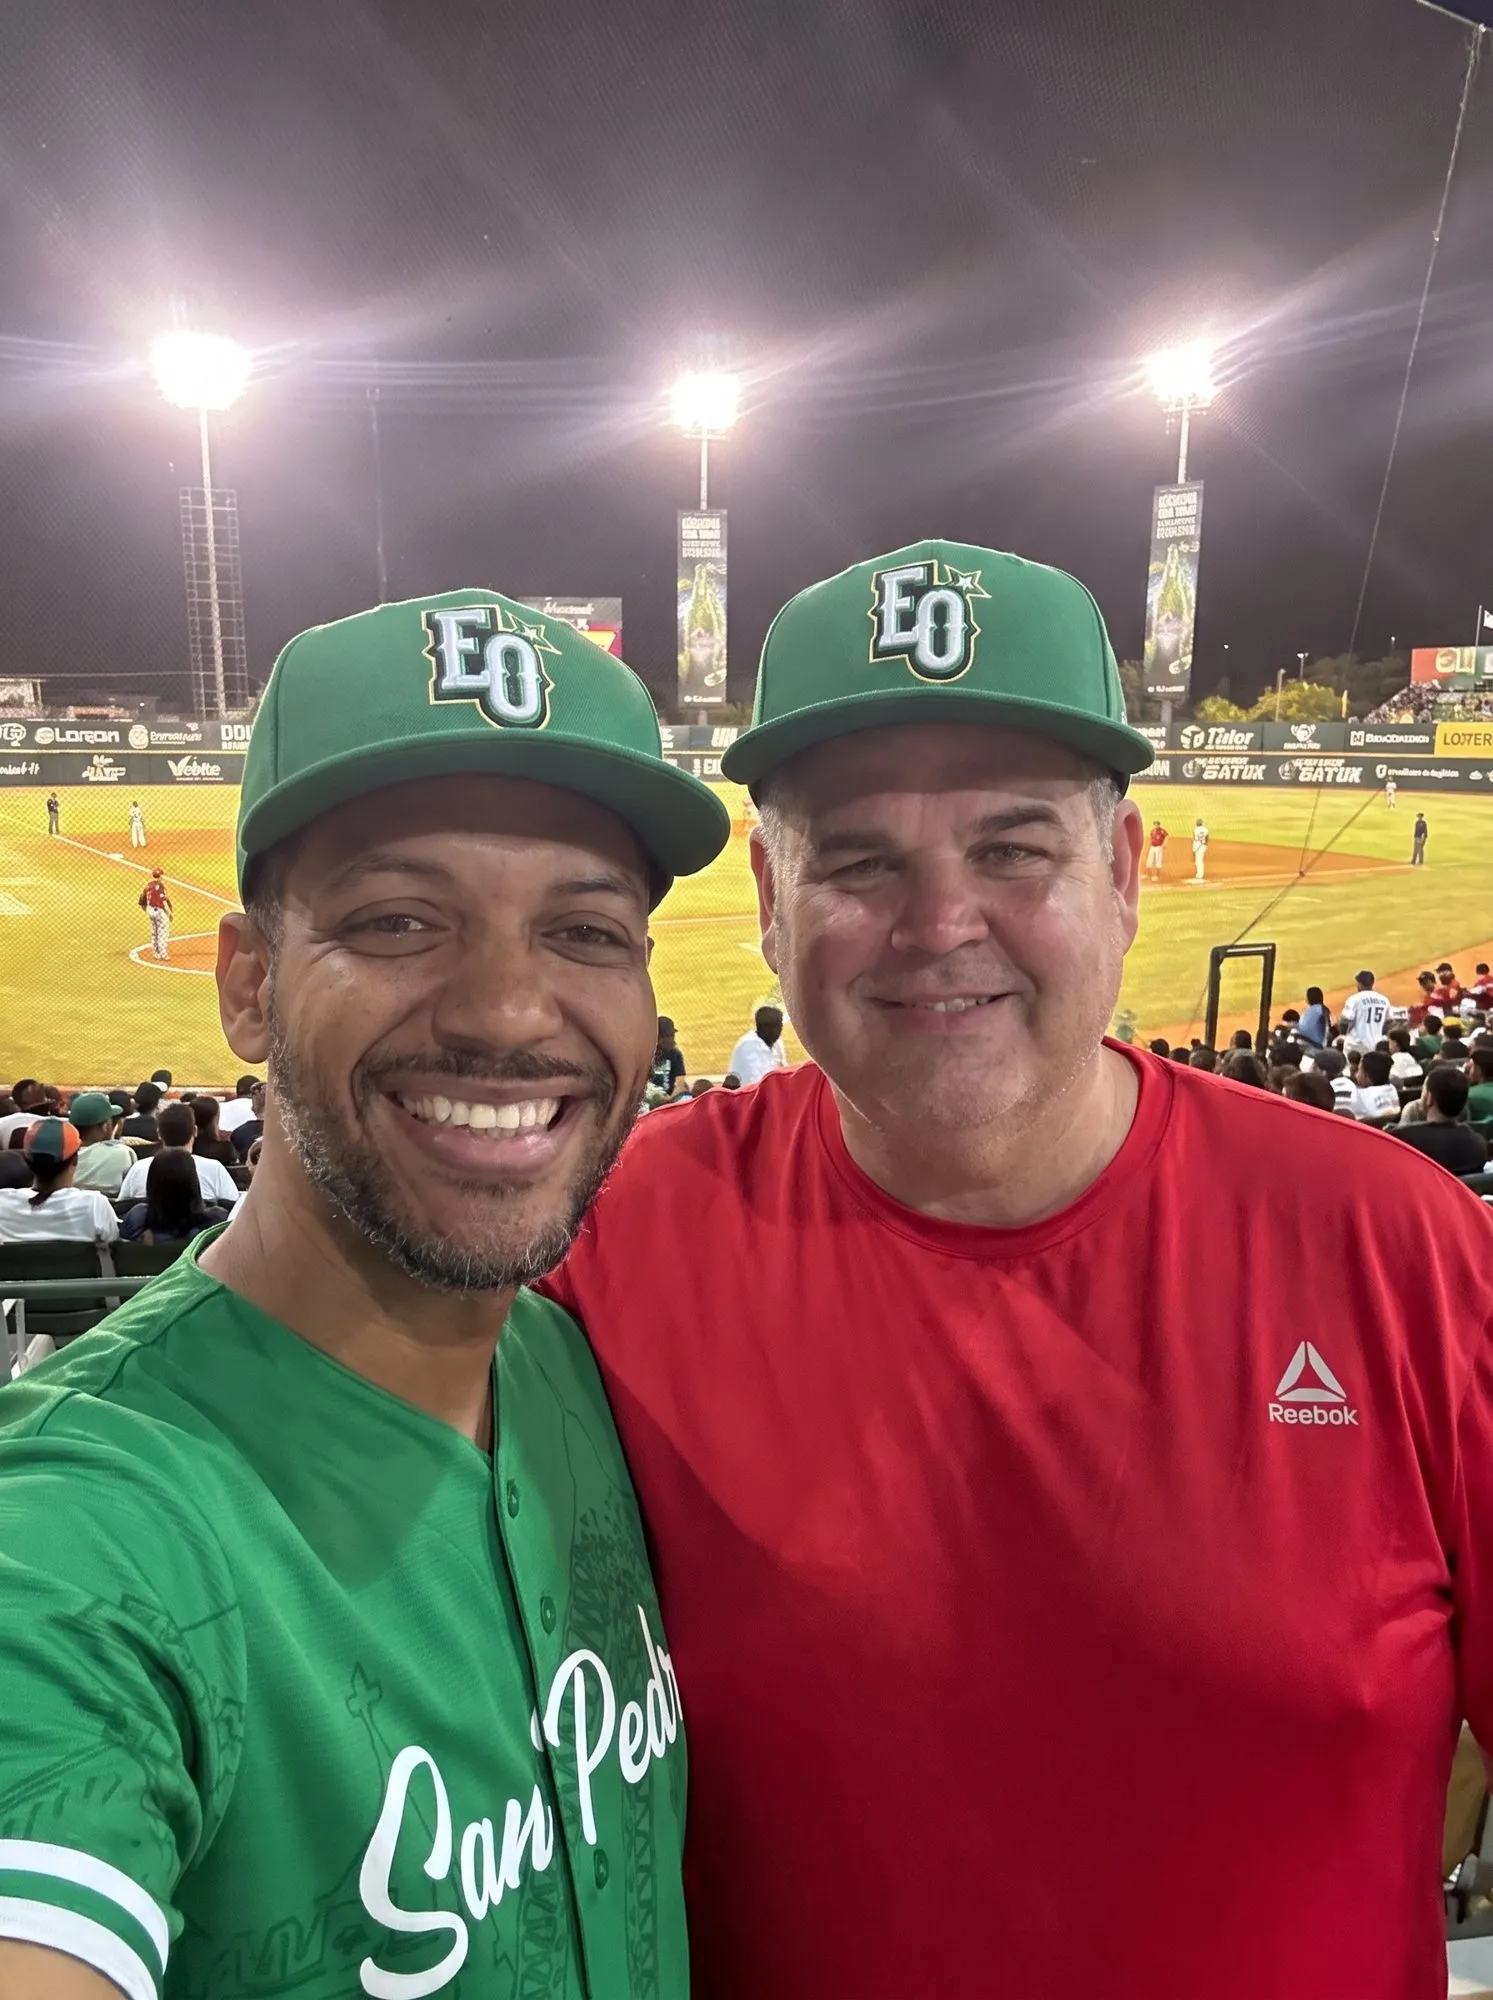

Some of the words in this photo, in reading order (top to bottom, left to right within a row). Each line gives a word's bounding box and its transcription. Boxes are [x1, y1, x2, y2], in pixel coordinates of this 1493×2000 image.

[431, 606, 546, 724] EO
[875, 564, 969, 674] EO
[1366, 1006, 1384, 1024] 15
[1268, 1403, 1359, 1425] Reebok
[359, 1745, 555, 2000] San
